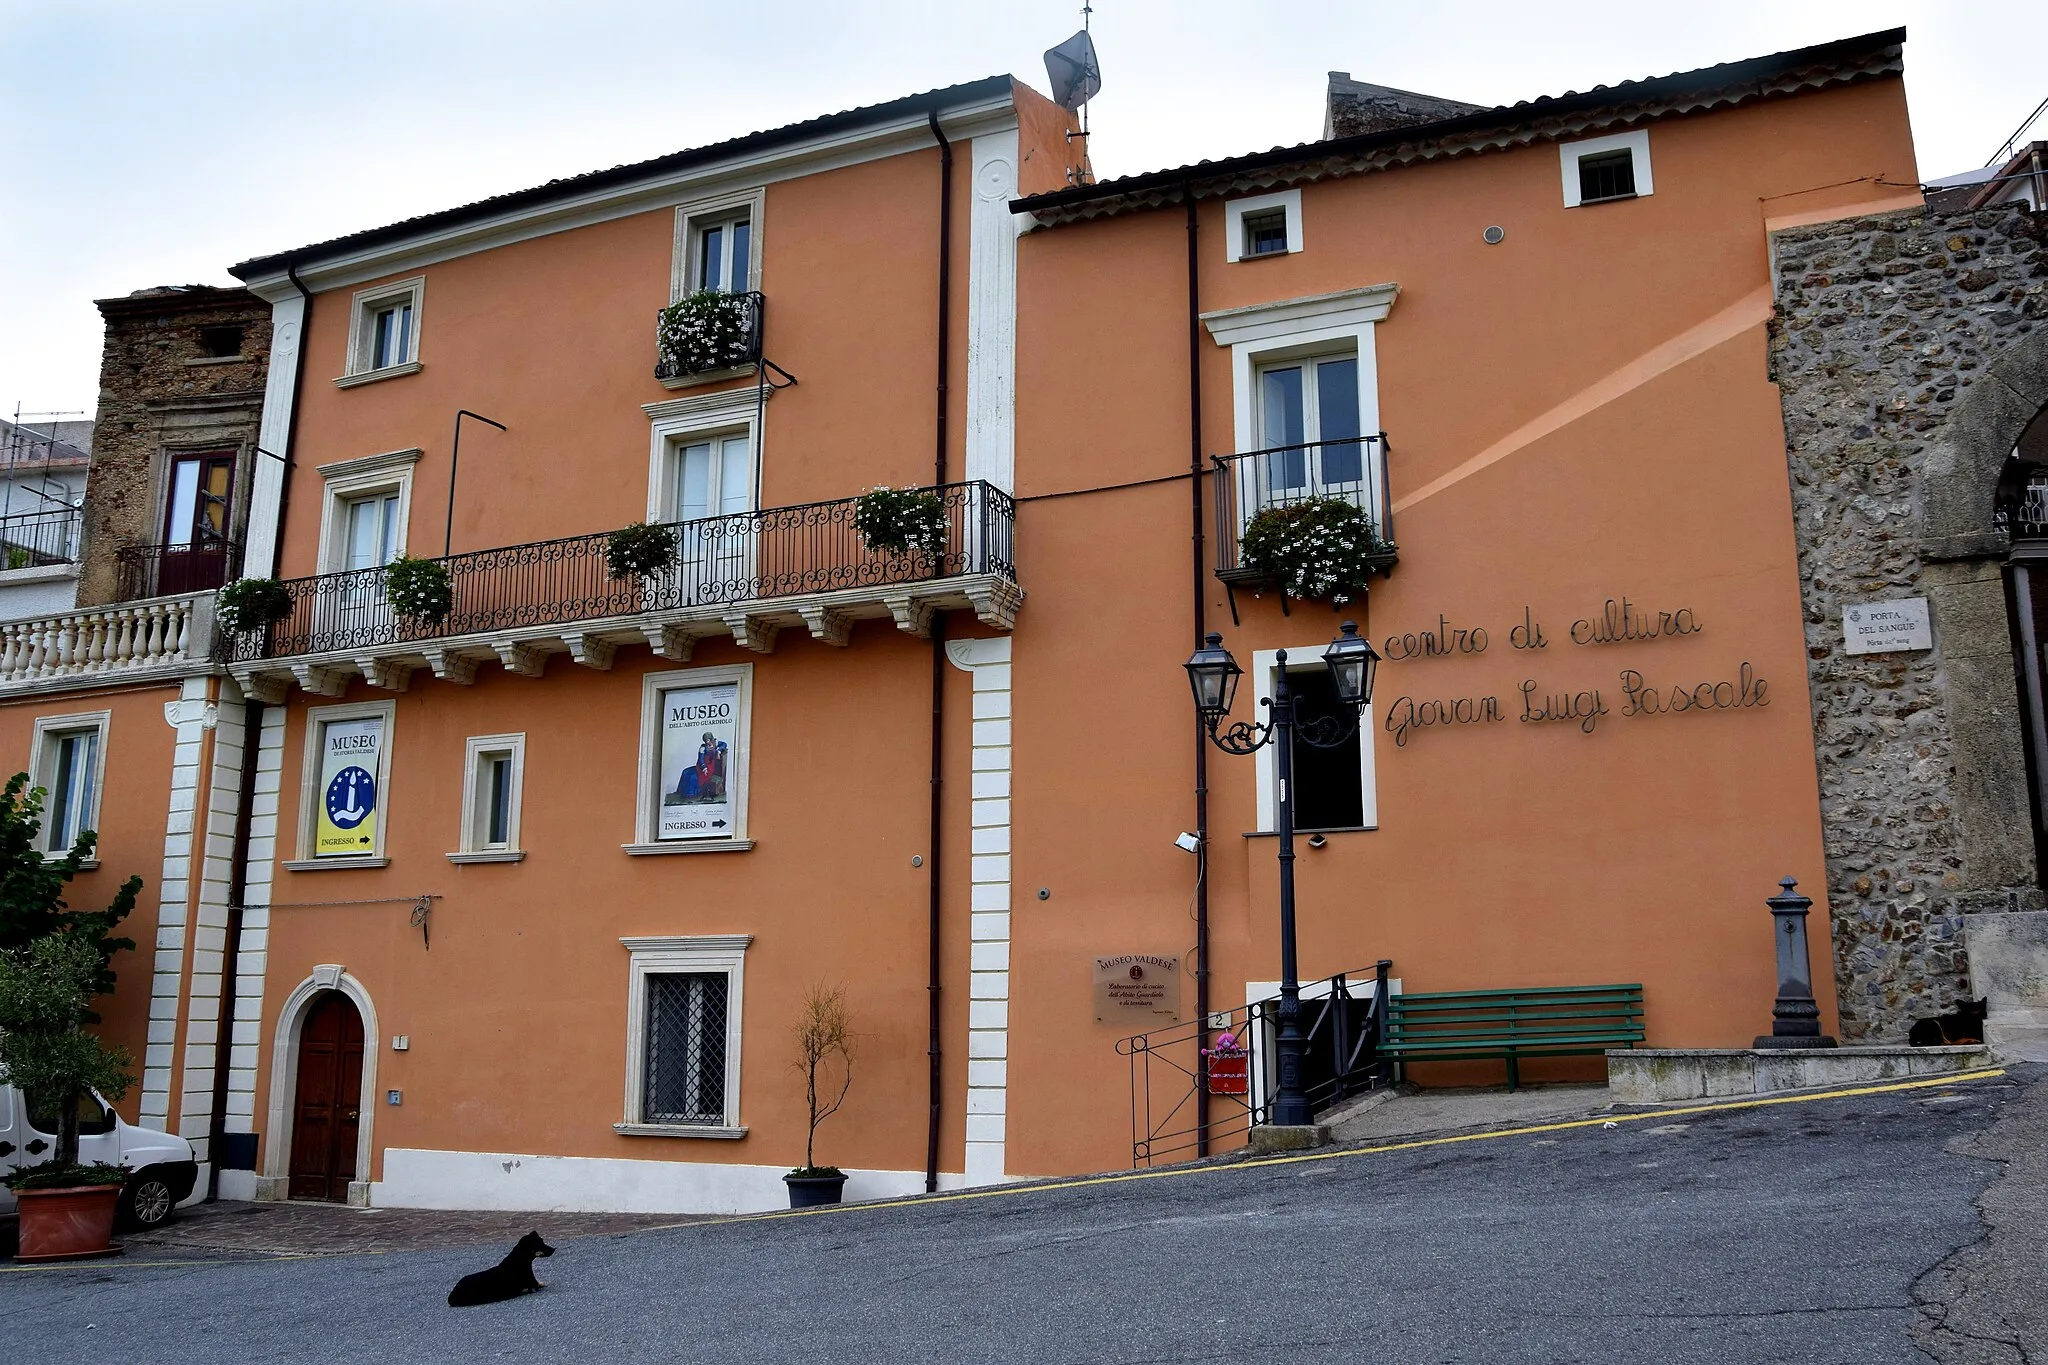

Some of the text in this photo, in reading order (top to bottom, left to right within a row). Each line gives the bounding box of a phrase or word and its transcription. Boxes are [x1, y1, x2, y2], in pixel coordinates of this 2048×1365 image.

[1870, 612, 1900, 620] PORTA
[1384, 596, 1703, 661] centro di cultura
[1878, 623, 1915, 632] SANGUE
[1385, 661, 1771, 748] Giovan Luigi Pascale
[672, 703, 729, 721] MUSEO
[668, 718, 733, 729] DELL'ABITO GUARDIOLO
[331, 735, 376, 750] MUSEO
[664, 820, 707, 831] INGRESSO
[321, 838, 355, 846] INGRESSO
[1099, 955, 1174, 972] MUSEO VALDESE
[1108, 982, 1141, 990] Laboratorio
[1136, 990, 1164, 999] Guardiolo
[1215, 1014, 1223, 1025] 2
